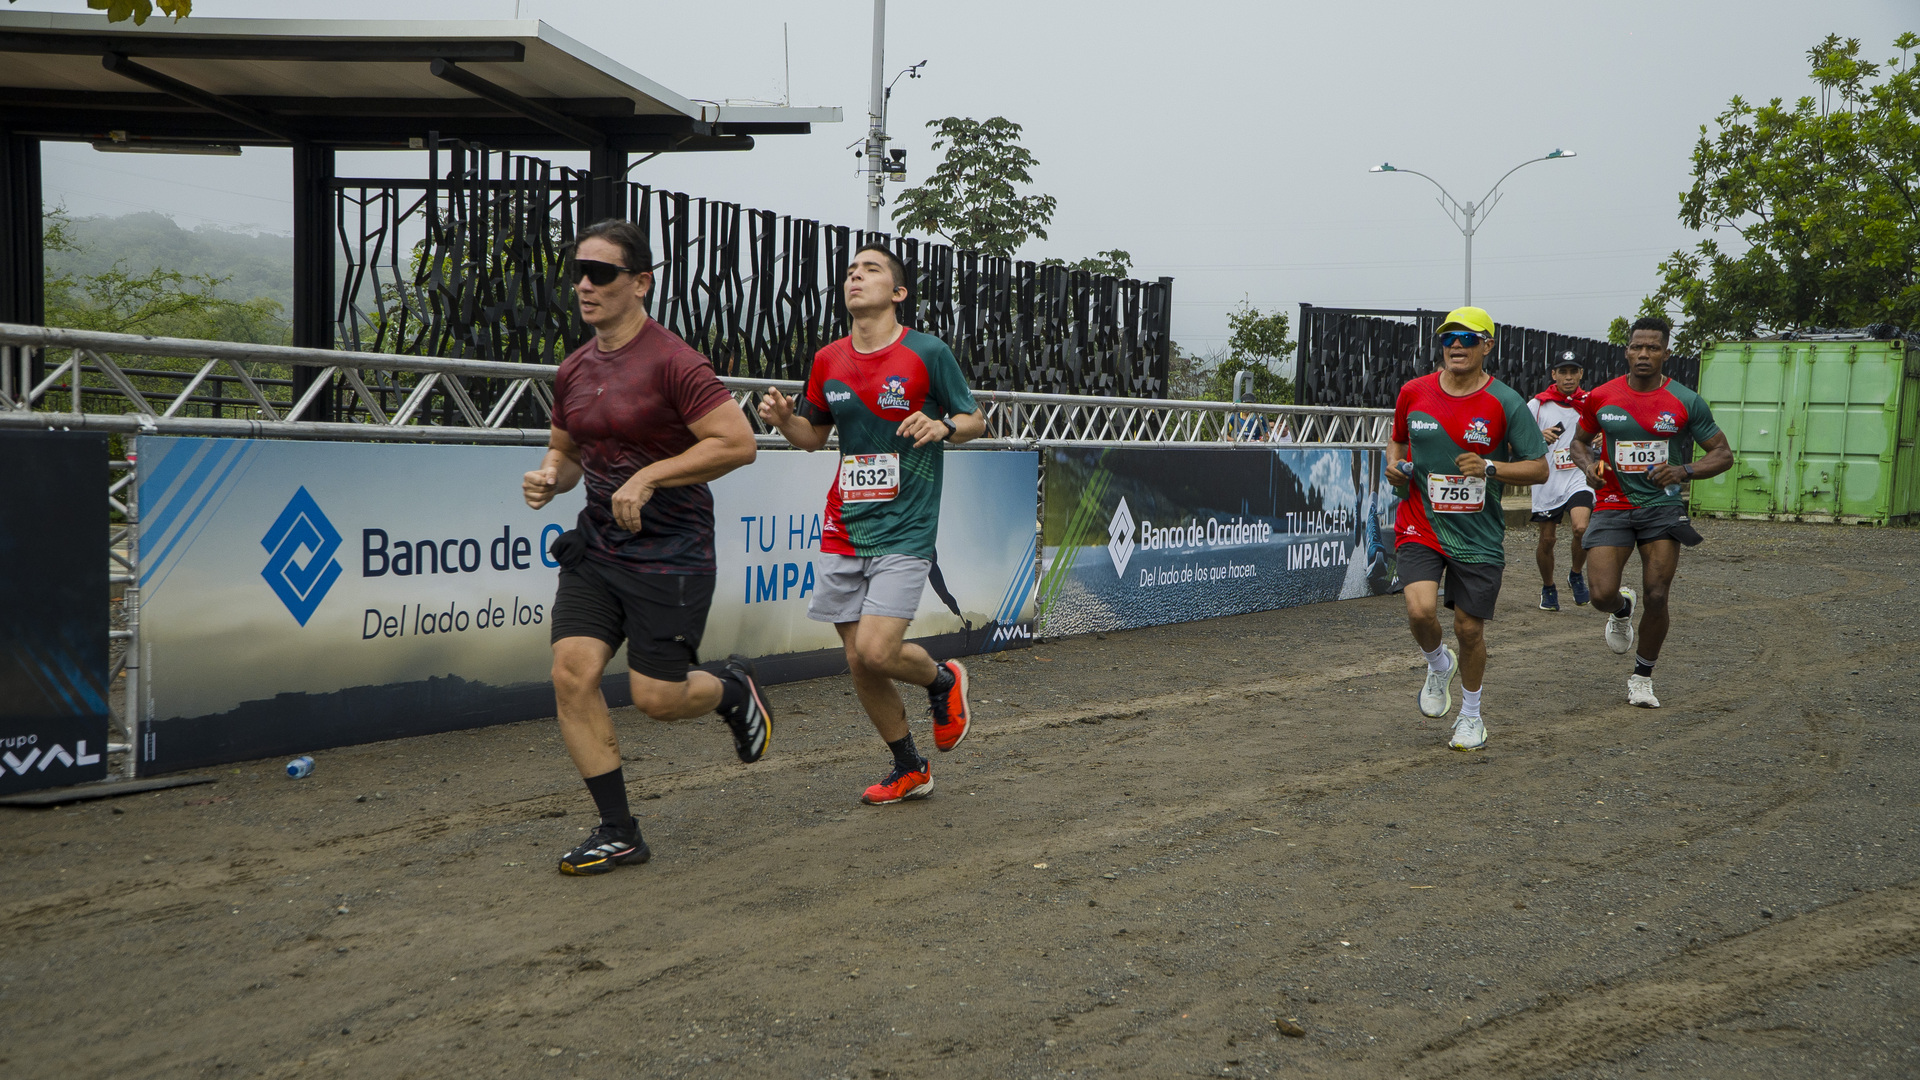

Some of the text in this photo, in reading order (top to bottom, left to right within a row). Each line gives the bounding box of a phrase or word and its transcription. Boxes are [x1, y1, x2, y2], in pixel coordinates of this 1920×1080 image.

[1629, 451, 1655, 462] 103
[848, 468, 888, 487] 1632
[1440, 487, 1469, 500] 756
[741, 515, 776, 553] TU
[1141, 516, 1270, 551] Banco de Occidente
[1286, 509, 1350, 537] TU HACER,
[362, 528, 481, 578] Banco
[490, 525, 532, 571] de
[1287, 541, 1350, 571] IMPACTA.
[745, 561, 815, 604] IMPA
[1140, 560, 1257, 587] Del lado de los que hacen.
[362, 596, 544, 640] Del lado de los
[993, 624, 1031, 642] AVAL
[0, 734, 38, 749] rupo
[0, 740, 100, 777] VAL
